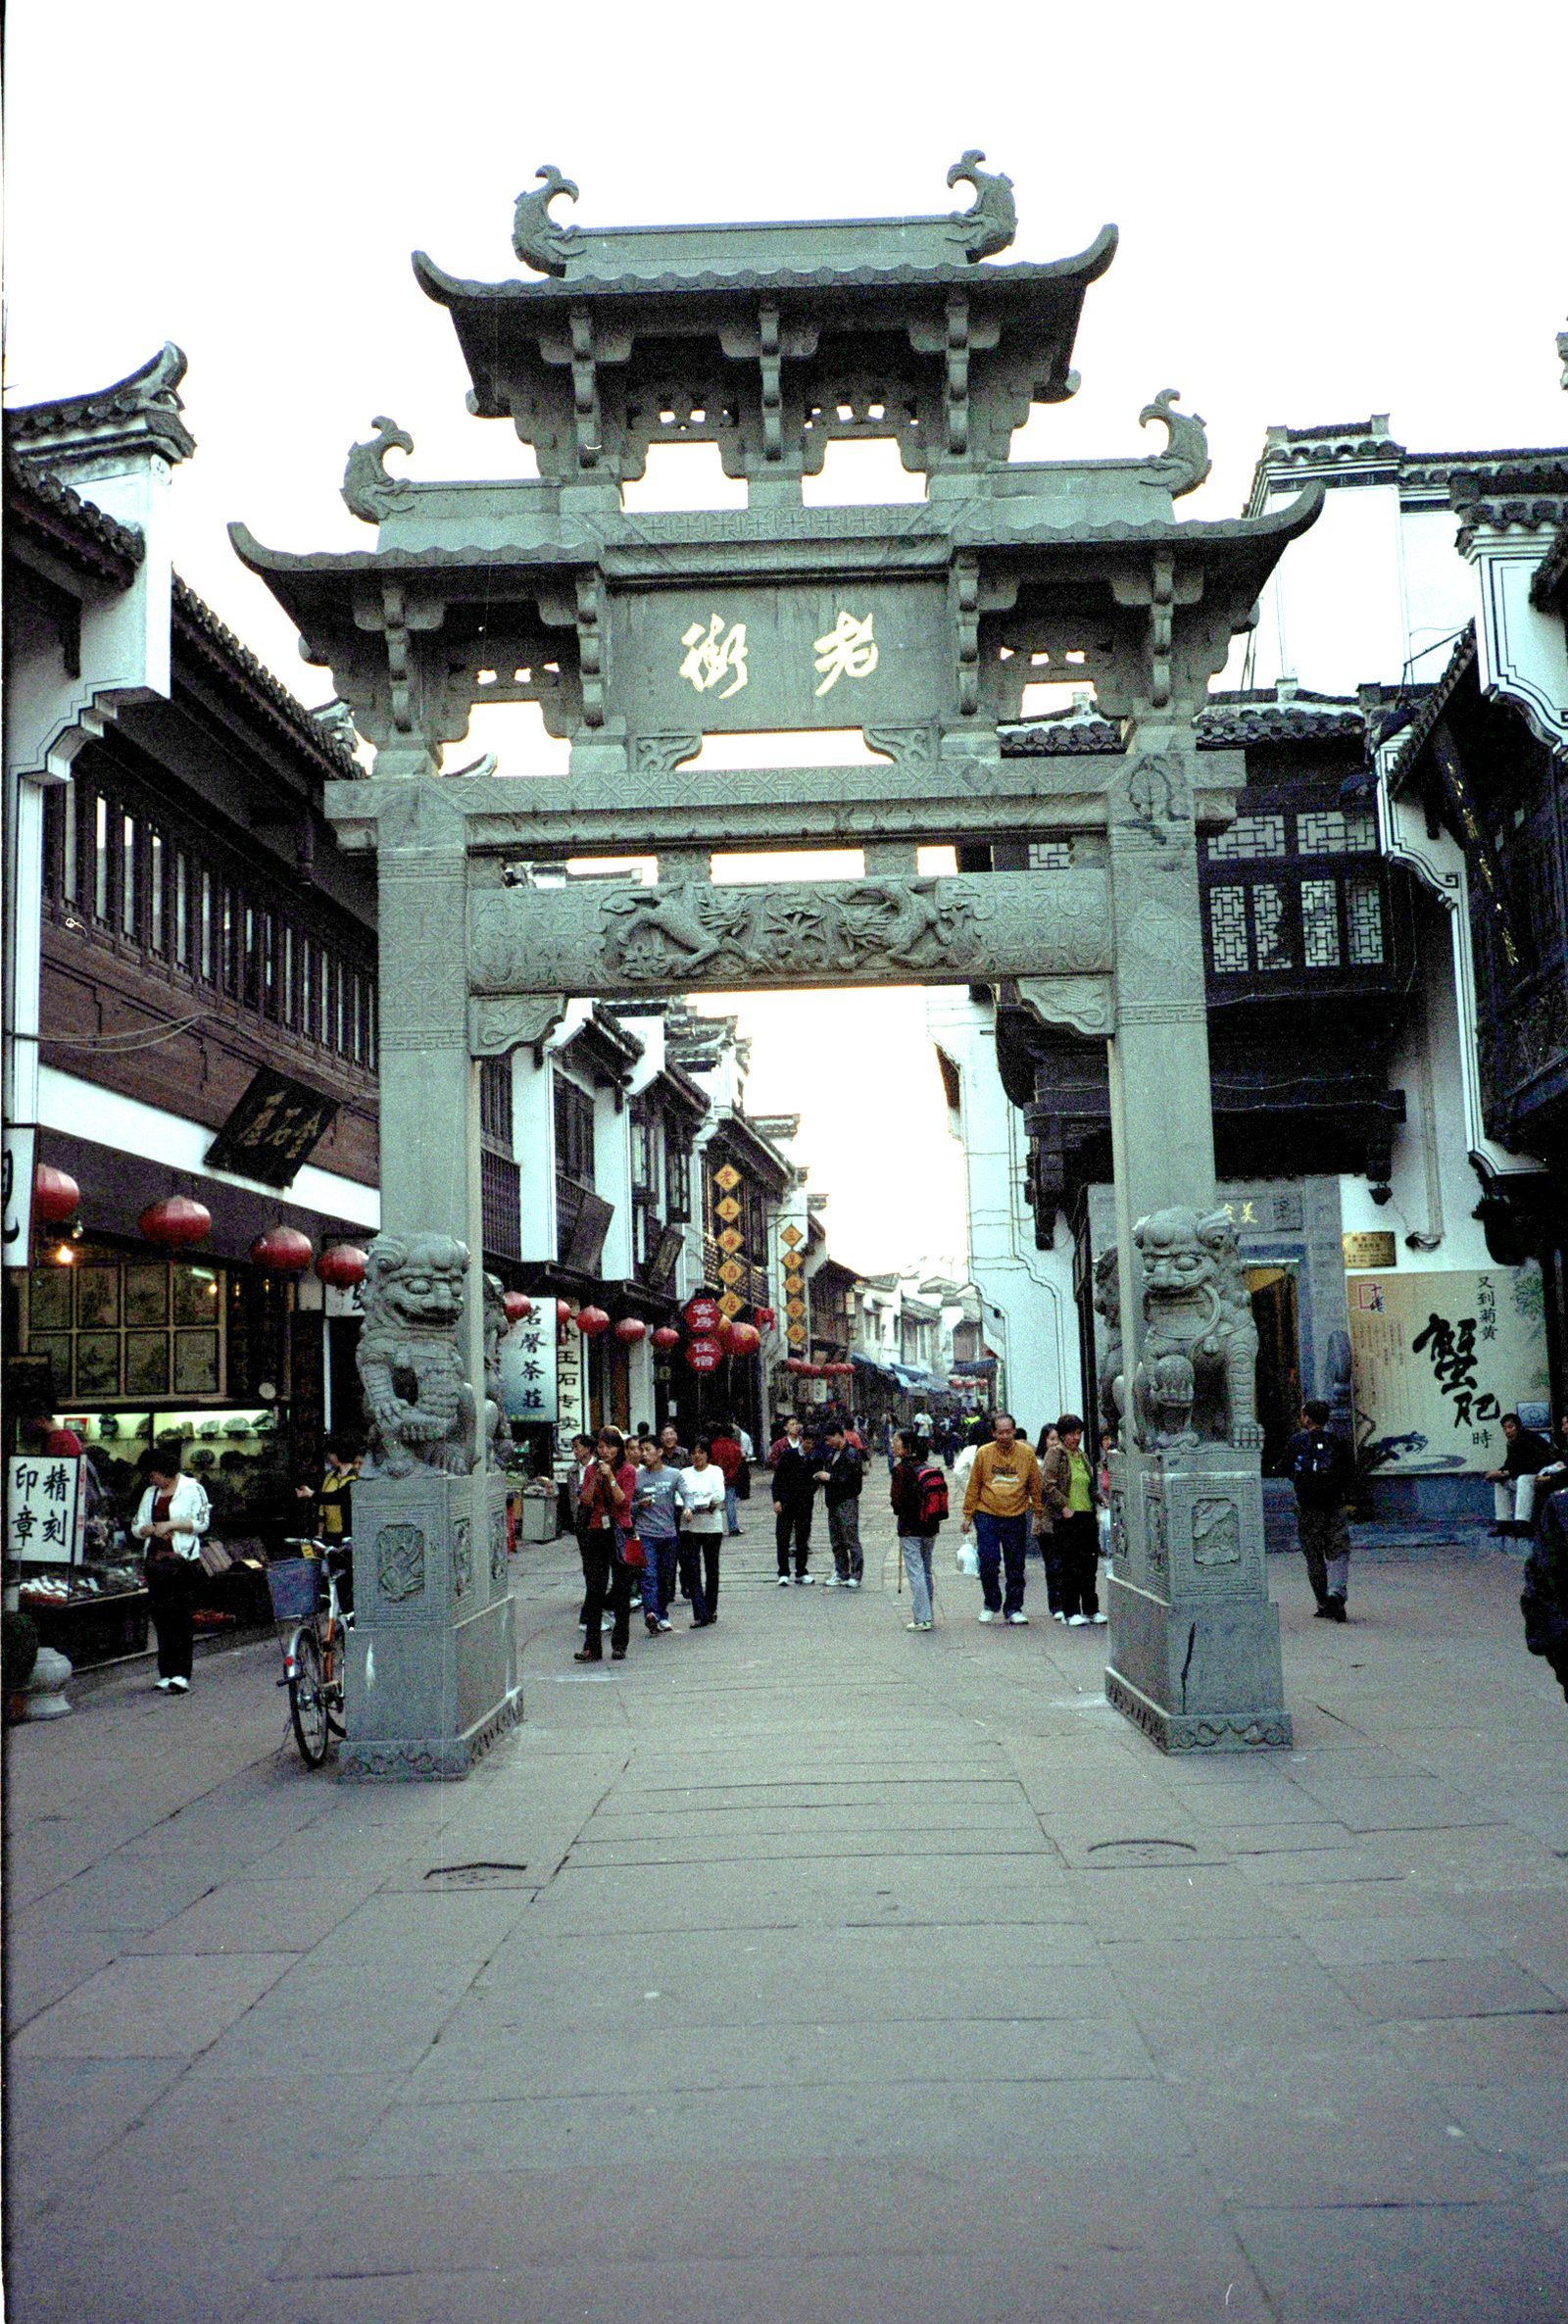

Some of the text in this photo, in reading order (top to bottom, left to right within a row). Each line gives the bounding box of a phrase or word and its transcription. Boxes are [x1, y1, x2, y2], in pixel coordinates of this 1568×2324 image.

[720, 1169, 738, 1312] 老上海酒店
[692, 1302, 714, 1328] 客房
[693, 1342, 714, 1367] 住宿
[1472, 1428, 1493, 1449] 時
[12, 1462, 38, 1547] 印章
[42, 1463, 71, 1547] 精刻
